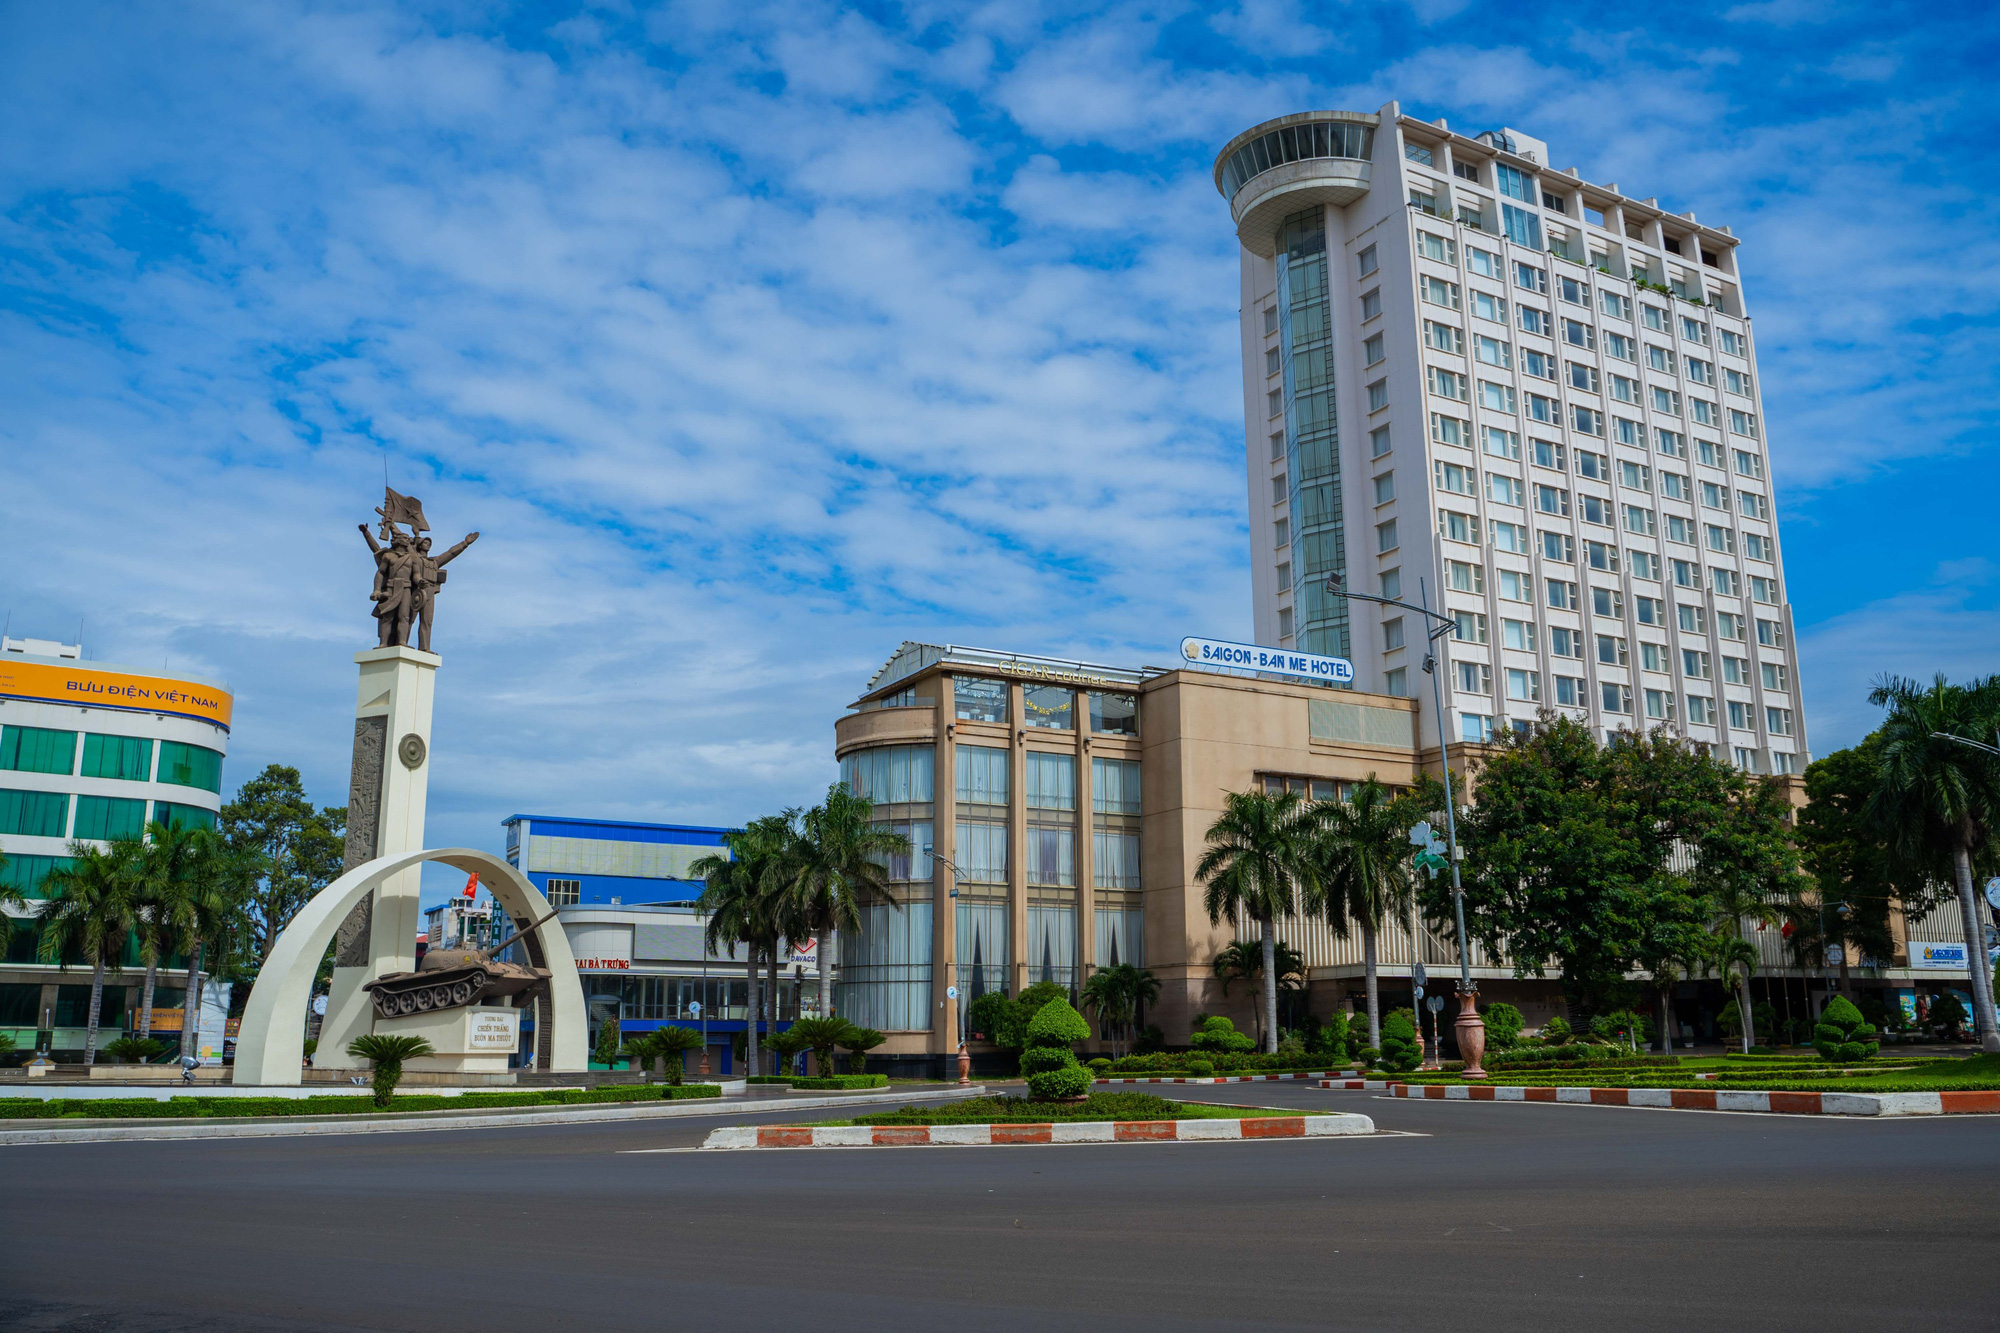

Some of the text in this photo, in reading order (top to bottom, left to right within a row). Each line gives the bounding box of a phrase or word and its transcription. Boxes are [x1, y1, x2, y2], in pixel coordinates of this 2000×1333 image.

[999, 660, 1107, 686] CIGAR LOUNGE
[1289, 656, 1308, 672] ME
[1311, 659, 1351, 678] HOTEL
[66, 680, 218, 710] BƯU ĐIỆN VIỆT NAM
[601, 958, 630, 970] TRƯNG
[487, 1034, 496, 1042] MA
